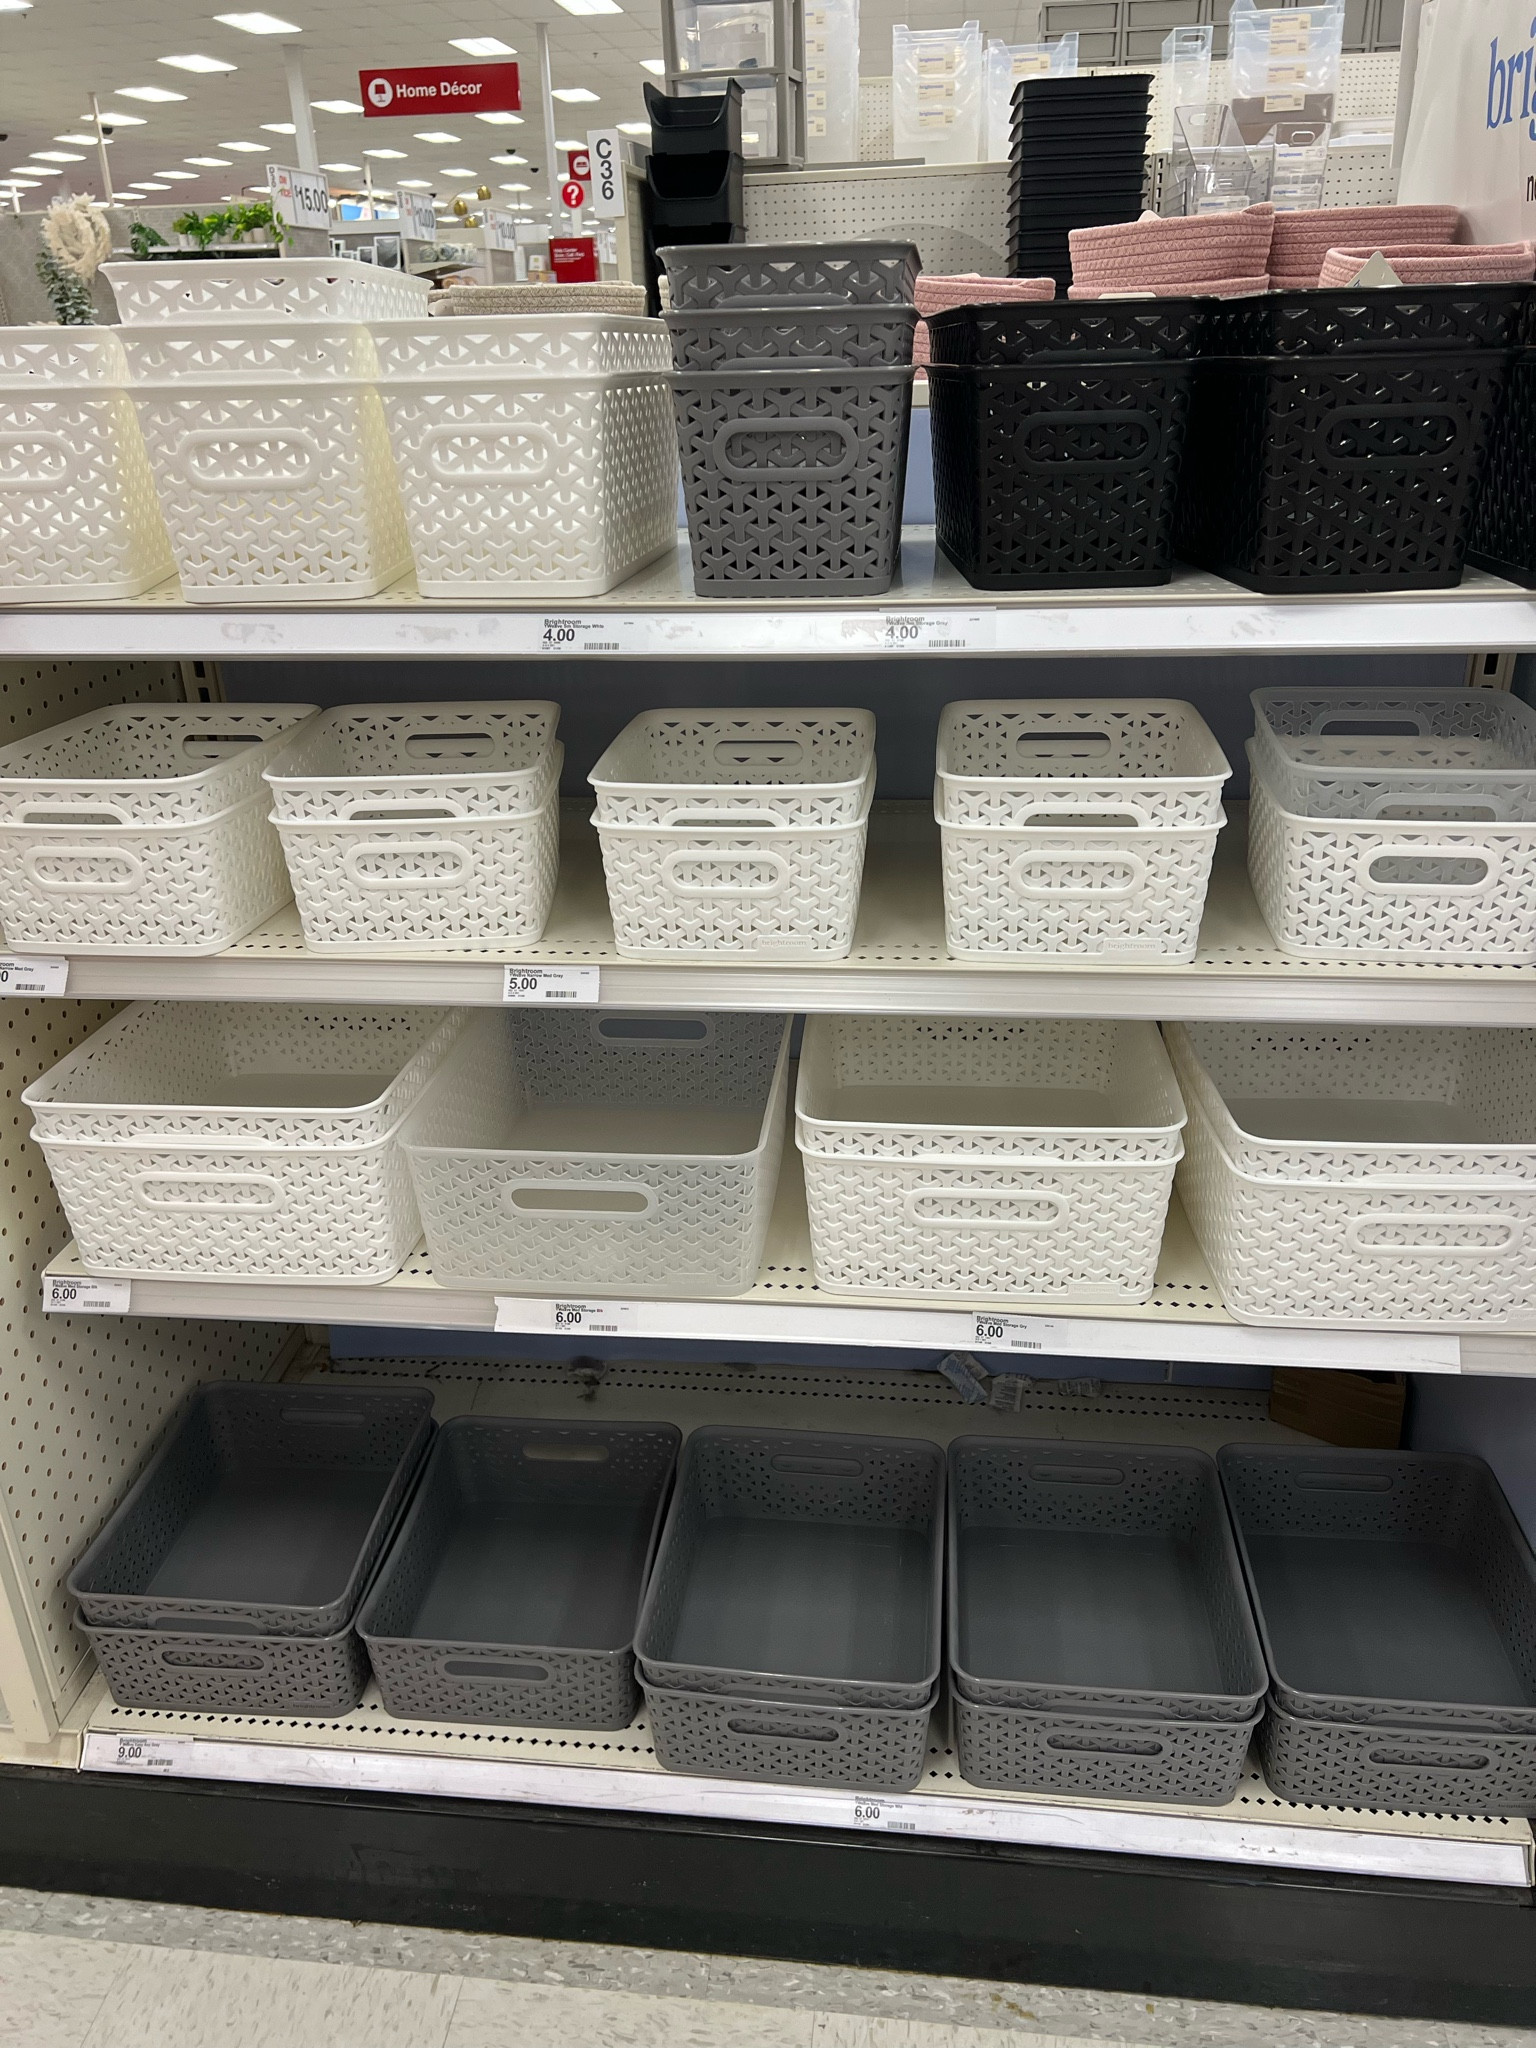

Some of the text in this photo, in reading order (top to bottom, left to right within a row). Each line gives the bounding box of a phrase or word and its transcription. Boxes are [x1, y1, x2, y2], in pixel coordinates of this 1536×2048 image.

[396, 81, 482, 98] Home Décor
[544, 618, 582, 627] Brightroom
[543, 628, 575, 641] 4.00
[885, 625, 919, 639] 4.00
[509, 977, 537, 990] 5.00
[52, 1287, 77, 1300] 6.00
[556, 1311, 582, 1324] 6.00
[976, 1324, 1004, 1338] 6.00
[118, 1746, 142, 1759] 9.00
[854, 1805, 881, 1820] 6.00
